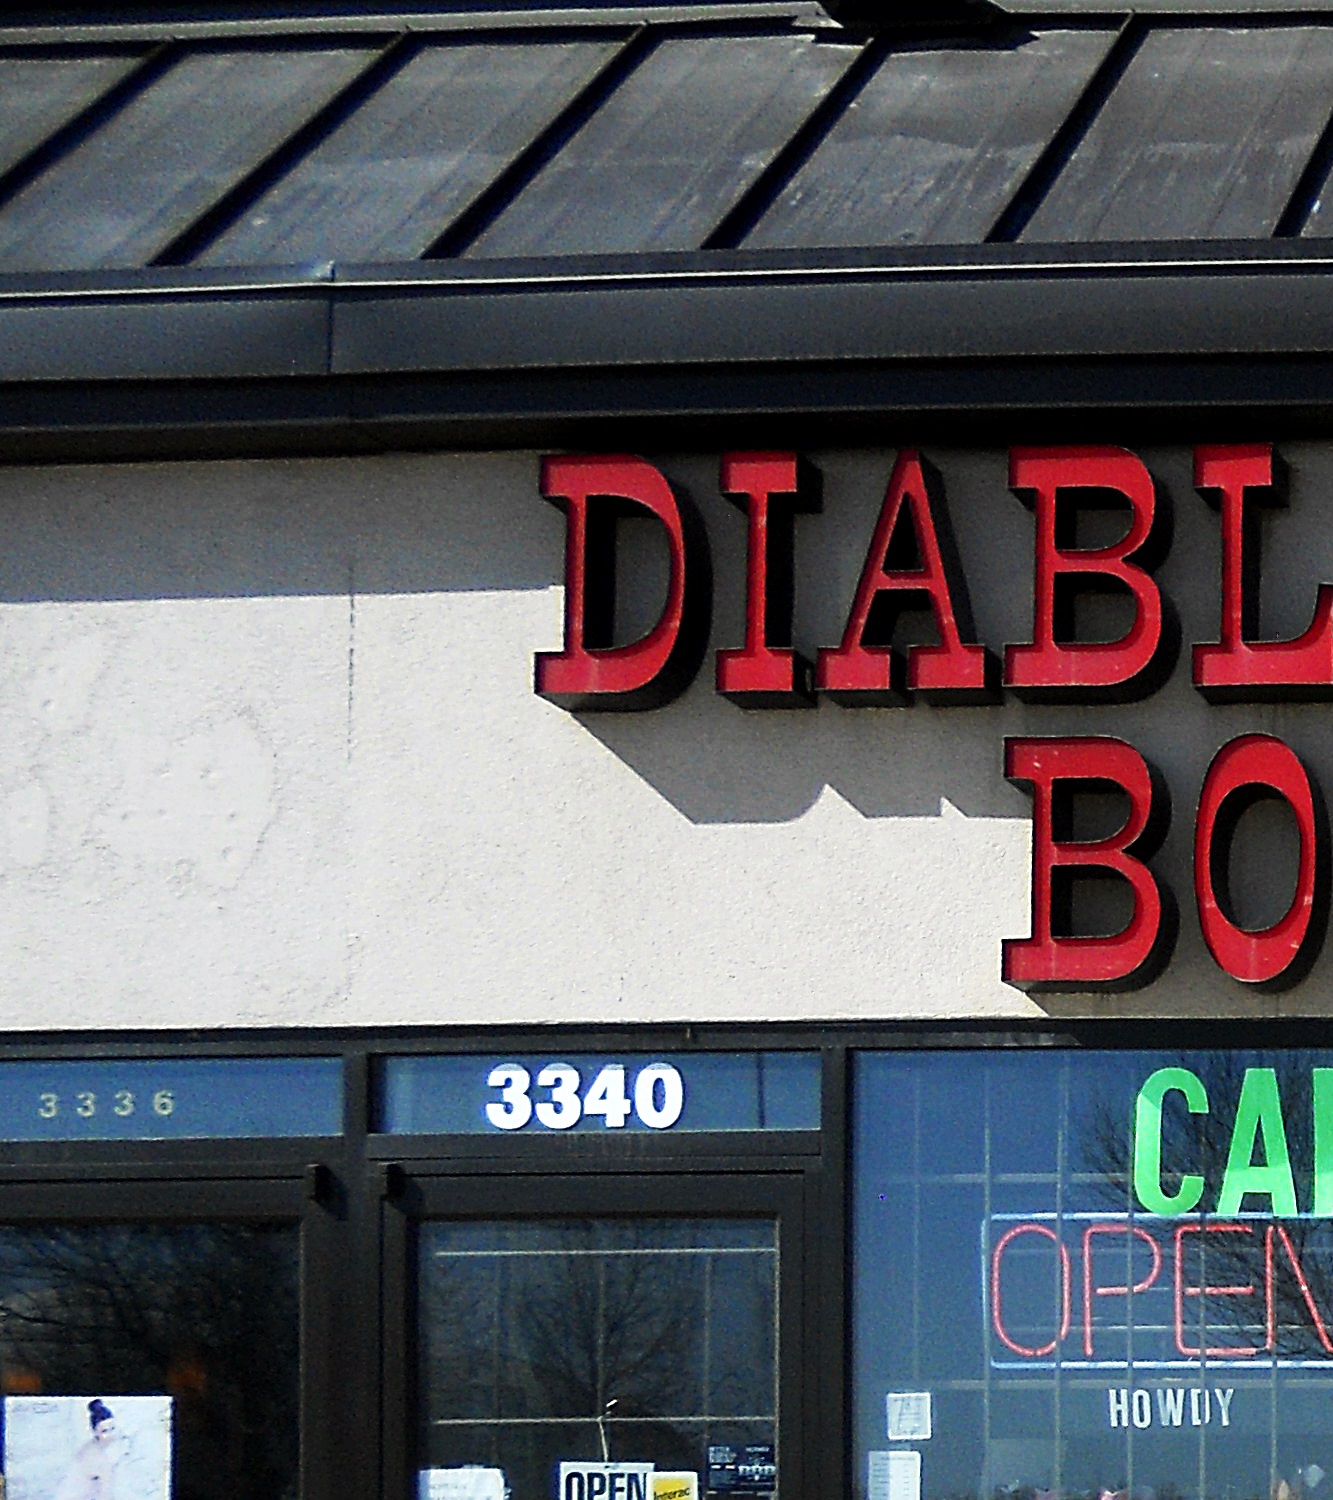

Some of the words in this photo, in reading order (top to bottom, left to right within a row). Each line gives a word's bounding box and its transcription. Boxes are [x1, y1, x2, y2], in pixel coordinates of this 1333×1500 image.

[38, 1089, 176, 1119] 3336
[485, 1063, 685, 1130] 3340
[1108, 1387, 1236, 1429] HOWDY
